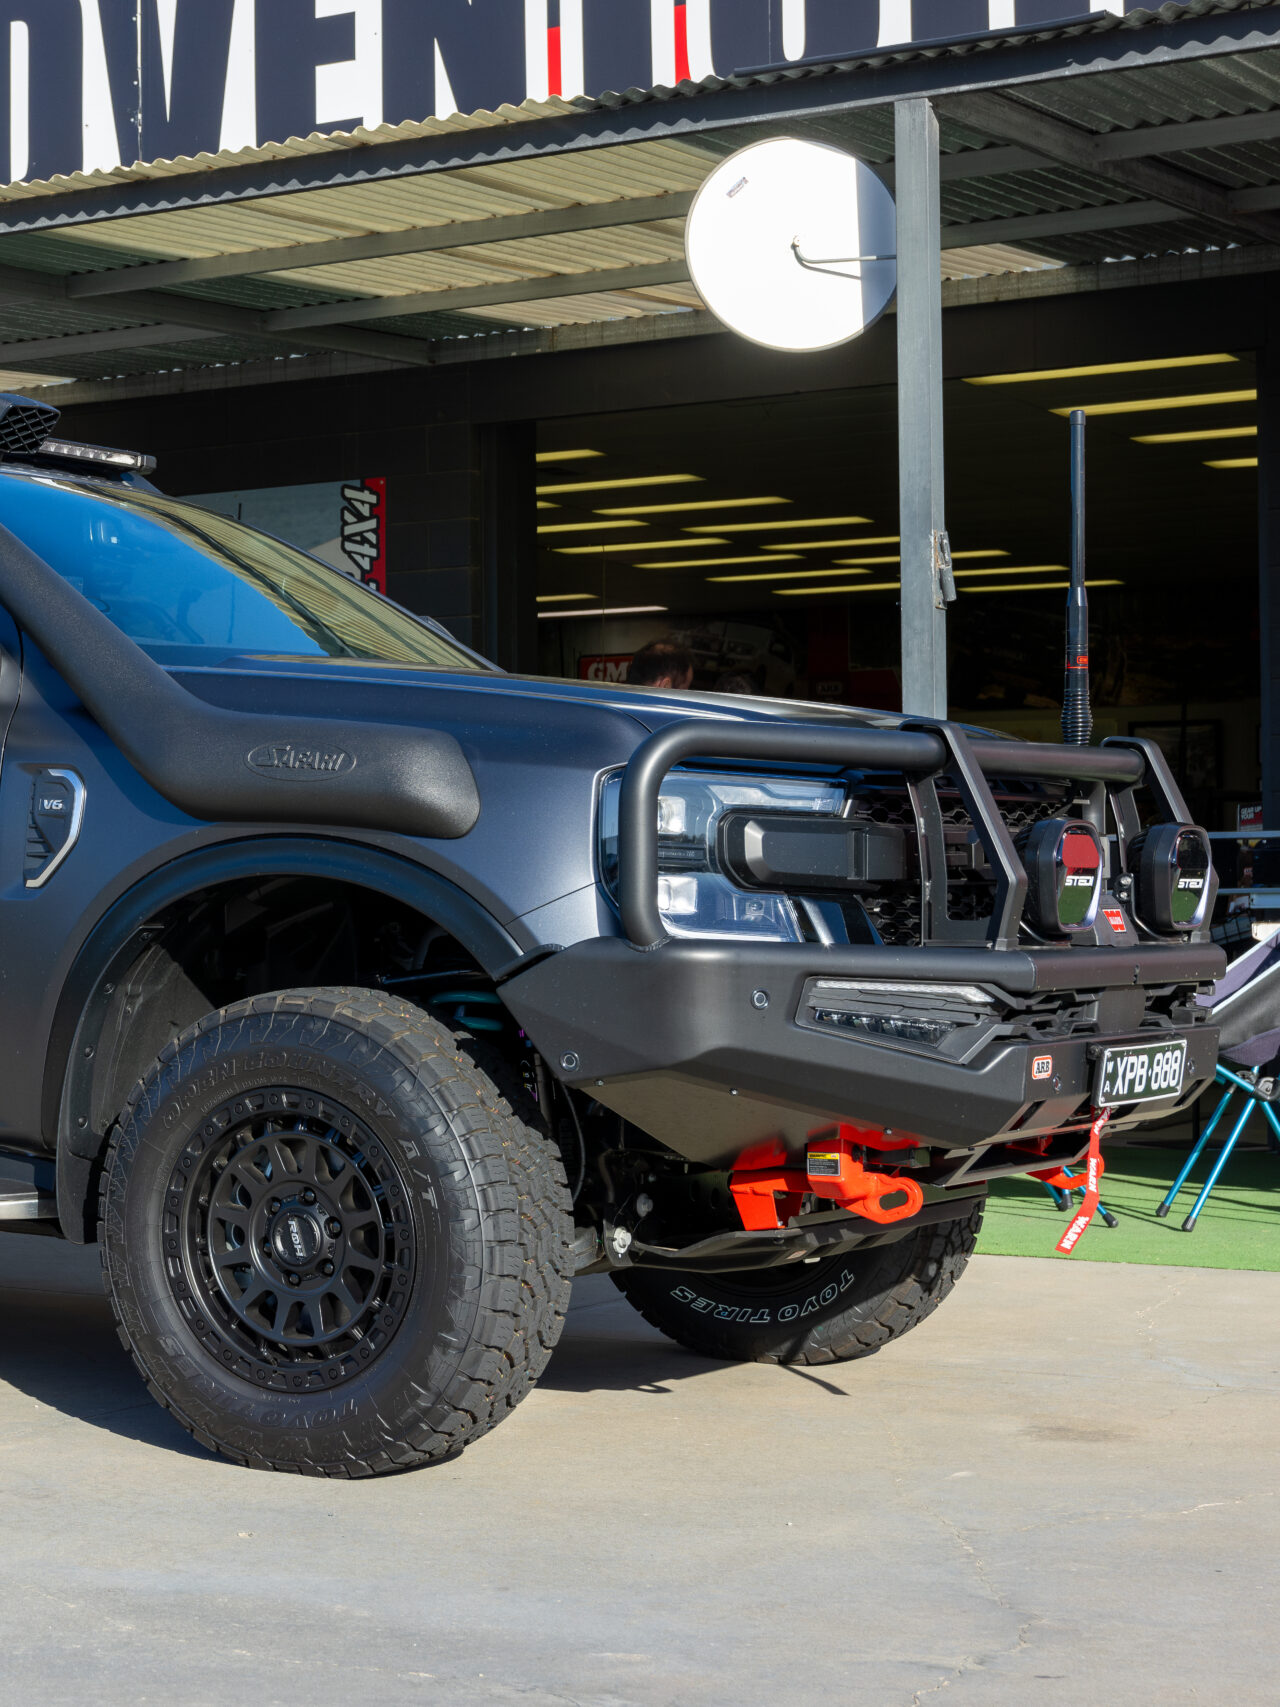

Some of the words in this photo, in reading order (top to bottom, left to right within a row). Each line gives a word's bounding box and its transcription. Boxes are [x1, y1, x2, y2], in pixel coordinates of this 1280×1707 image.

[43, 799, 64, 810] V6
[1064, 875, 1095, 887] STEDI
[1177, 878, 1204, 889] STEDI
[1035, 1060, 1051, 1075] ARB
[1088, 1157, 1098, 1193] WARN
[1060, 1216, 1090, 1250] WARN
[670, 1285, 770, 1323] TIRES
[778, 1269, 855, 1322] TOYO
